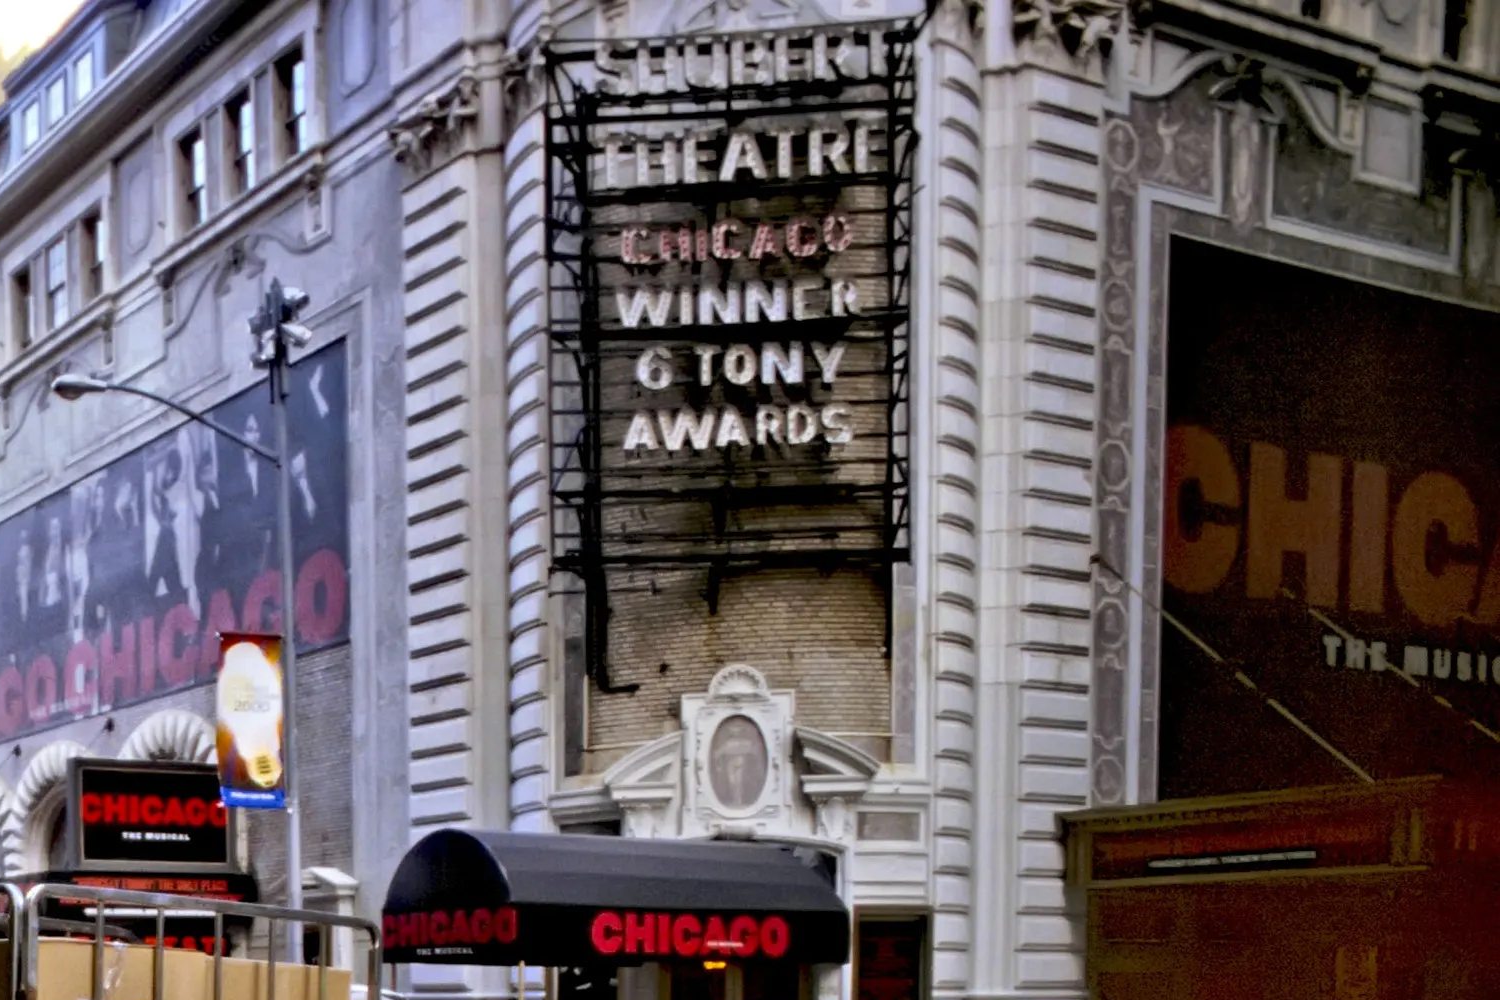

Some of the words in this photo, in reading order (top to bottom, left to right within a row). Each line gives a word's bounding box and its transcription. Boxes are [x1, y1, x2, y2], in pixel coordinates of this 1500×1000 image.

[595, 31, 888, 96] SHUBERT
[603, 116, 882, 187] THEATRE
[620, 215, 855, 265] CHICAGO
[616, 278, 860, 328] WINNER
[635, 346, 673, 391] 6
[695, 341, 848, 387] TONY
[622, 403, 856, 451] AWARDS
[1161, 424, 1500, 628] CHIC
[64, 548, 347, 717] CHICAGO
[1323, 634, 1387, 672] THE
[82, 792, 227, 827] CHICAGO
[121, 831, 143, 841] THE
[145, 831, 191, 842] MUSICAL
[383, 906, 520, 950] CHICAGO
[590, 909, 792, 959] CHICAGO
